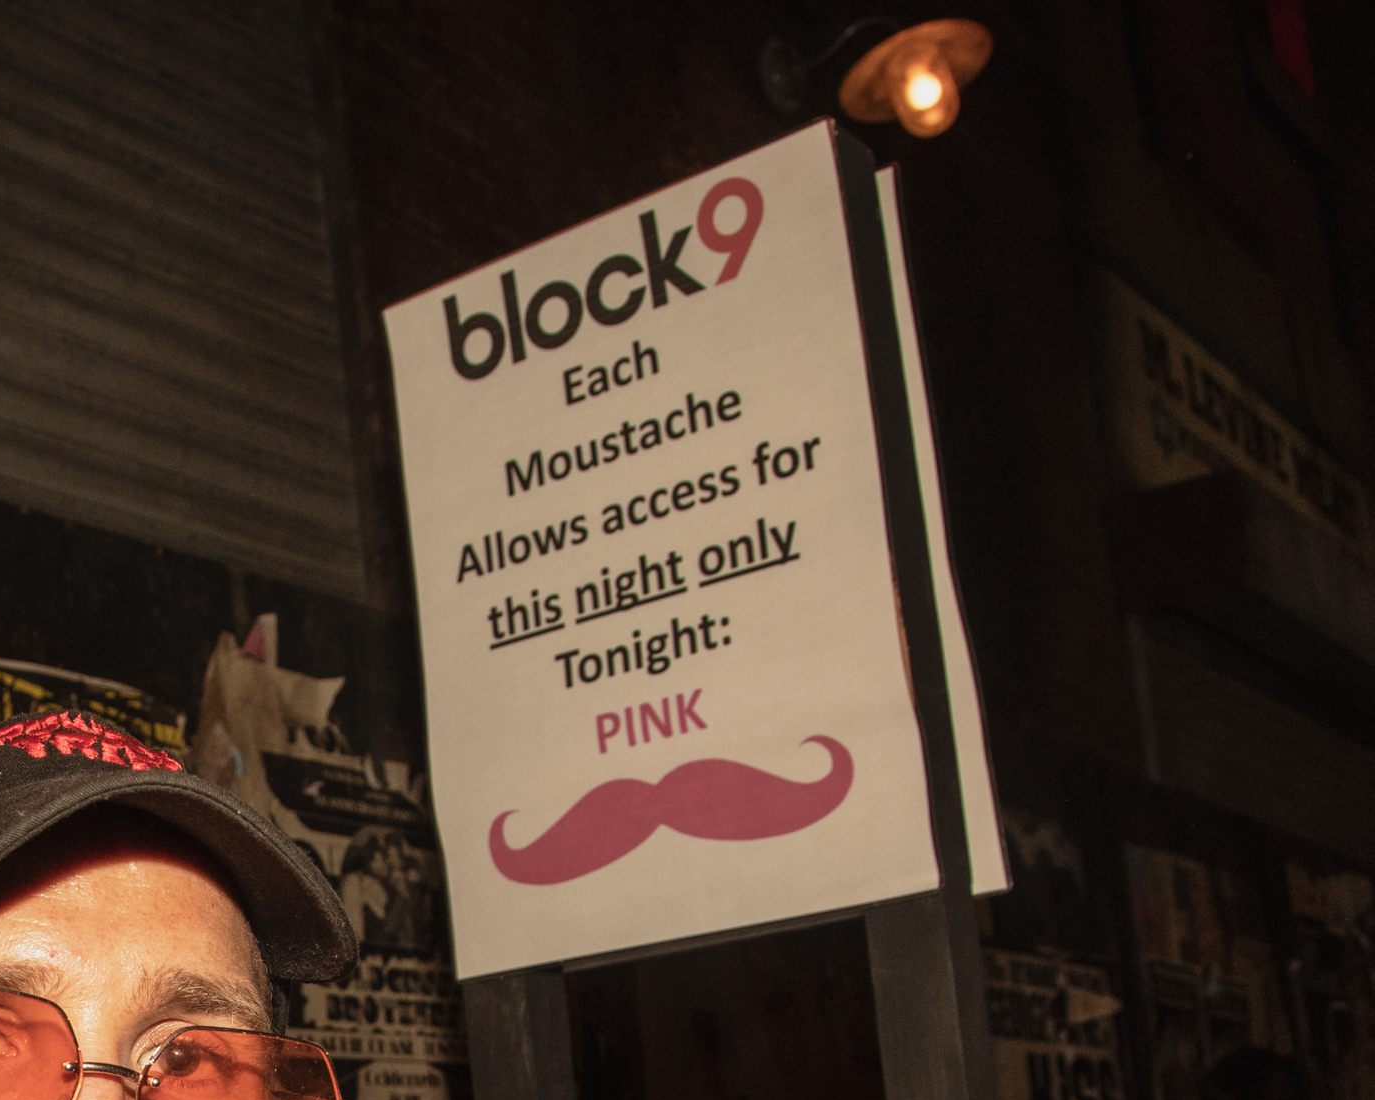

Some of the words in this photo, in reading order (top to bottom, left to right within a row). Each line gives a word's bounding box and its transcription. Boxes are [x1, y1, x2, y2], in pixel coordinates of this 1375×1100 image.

[562, 339, 660, 406] Each
[504, 389, 742, 497] Moustache
[457, 513, 589, 584] Allows
[601, 464, 741, 535] access
[752, 437, 822, 486] for
[488, 589, 564, 645] this
[575, 550, 687, 615] night
[698, 517, 798, 580] only
[554, 614, 732, 689] Tonight:
[595, 688, 707, 755] PINK
